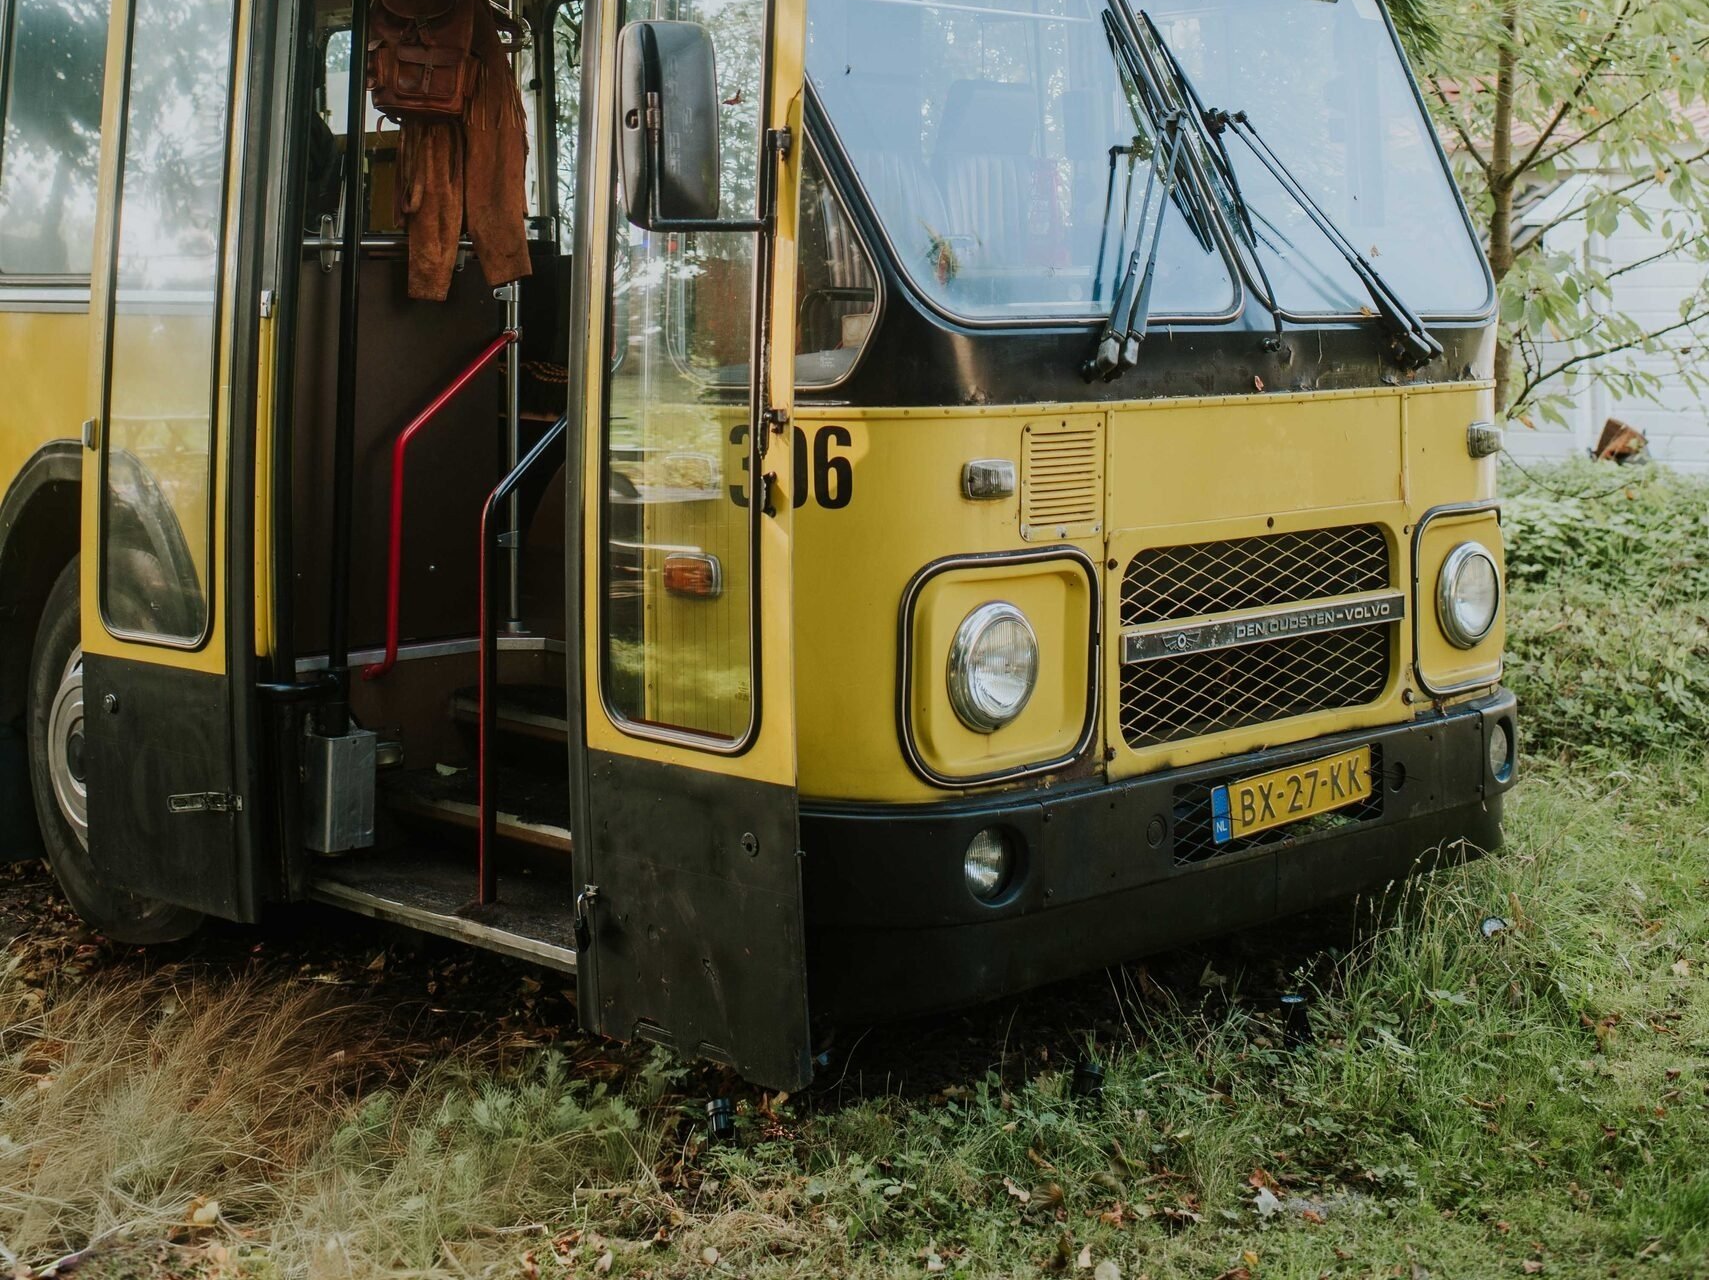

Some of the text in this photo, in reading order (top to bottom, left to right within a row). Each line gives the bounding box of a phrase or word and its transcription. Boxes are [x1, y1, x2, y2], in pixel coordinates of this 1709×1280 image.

[1236, 623, 1265, 638] DEN
[1240, 755, 1362, 827] BX-27-KK
[1216, 821, 1228, 833] NL
